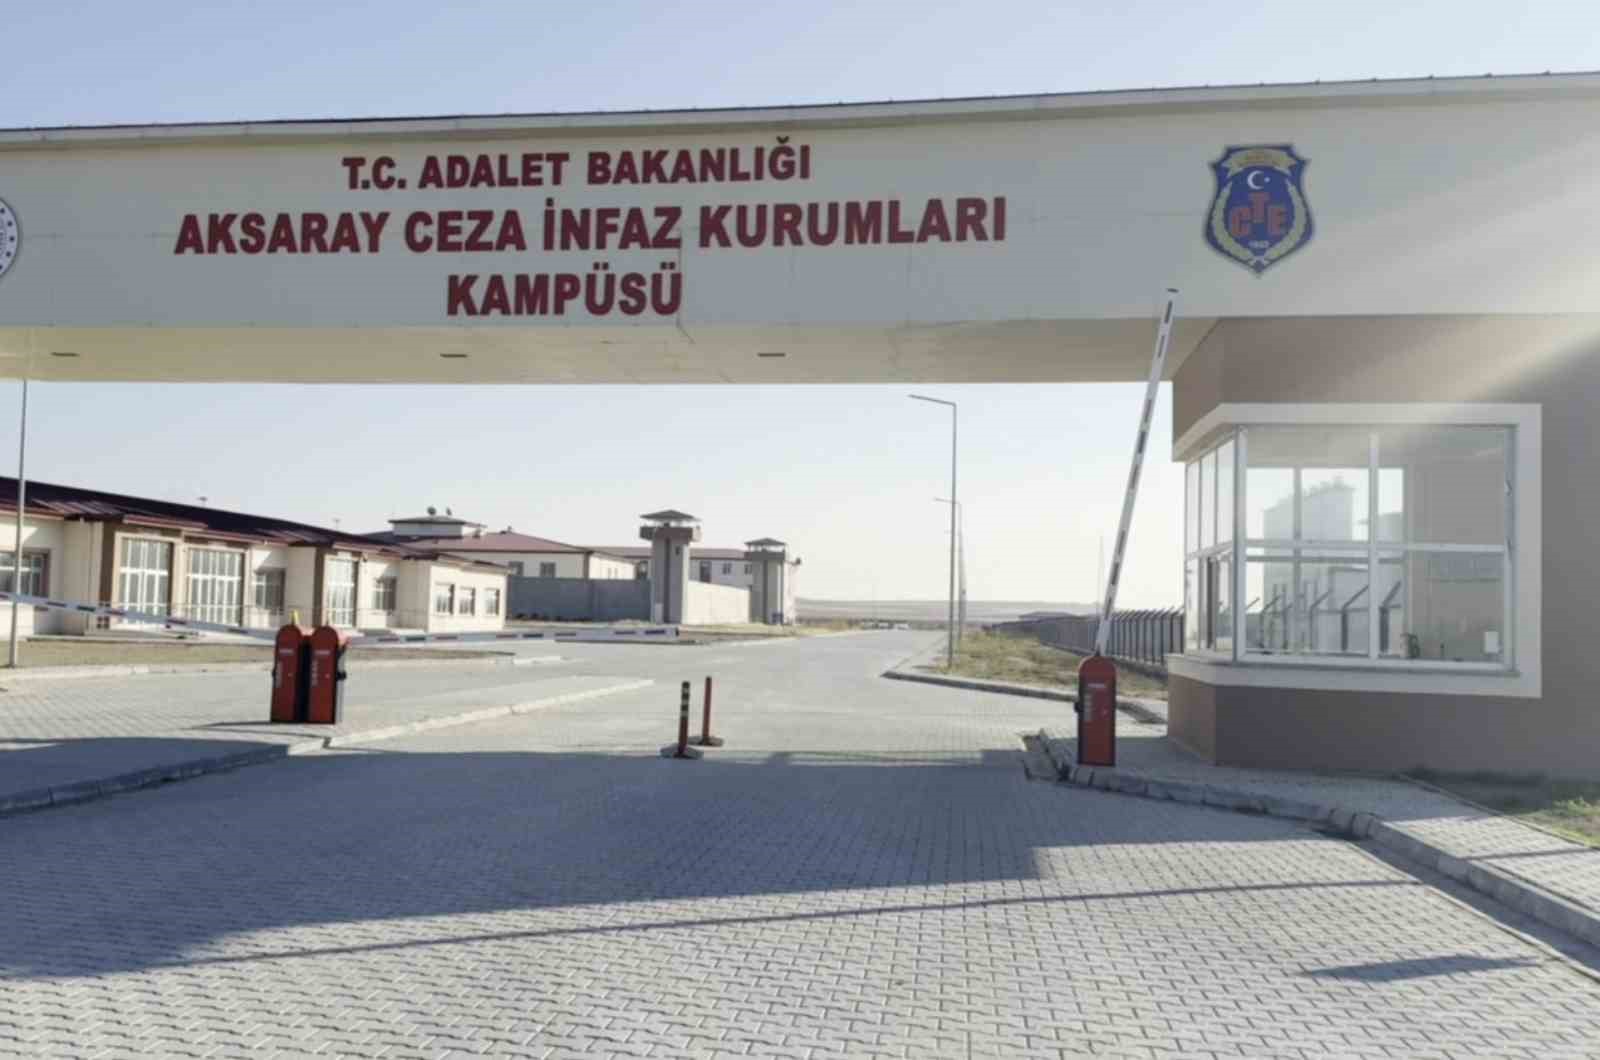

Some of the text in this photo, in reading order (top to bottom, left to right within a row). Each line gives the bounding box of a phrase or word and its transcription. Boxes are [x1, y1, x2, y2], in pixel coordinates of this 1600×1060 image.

[341, 135, 811, 191] T.C. ADALET BAKANLIĞI
[173, 196, 1006, 256] AKSARAY CEZA İNFAZ KURUMLARI
[447, 261, 683, 317] KAMPÜSÜ
